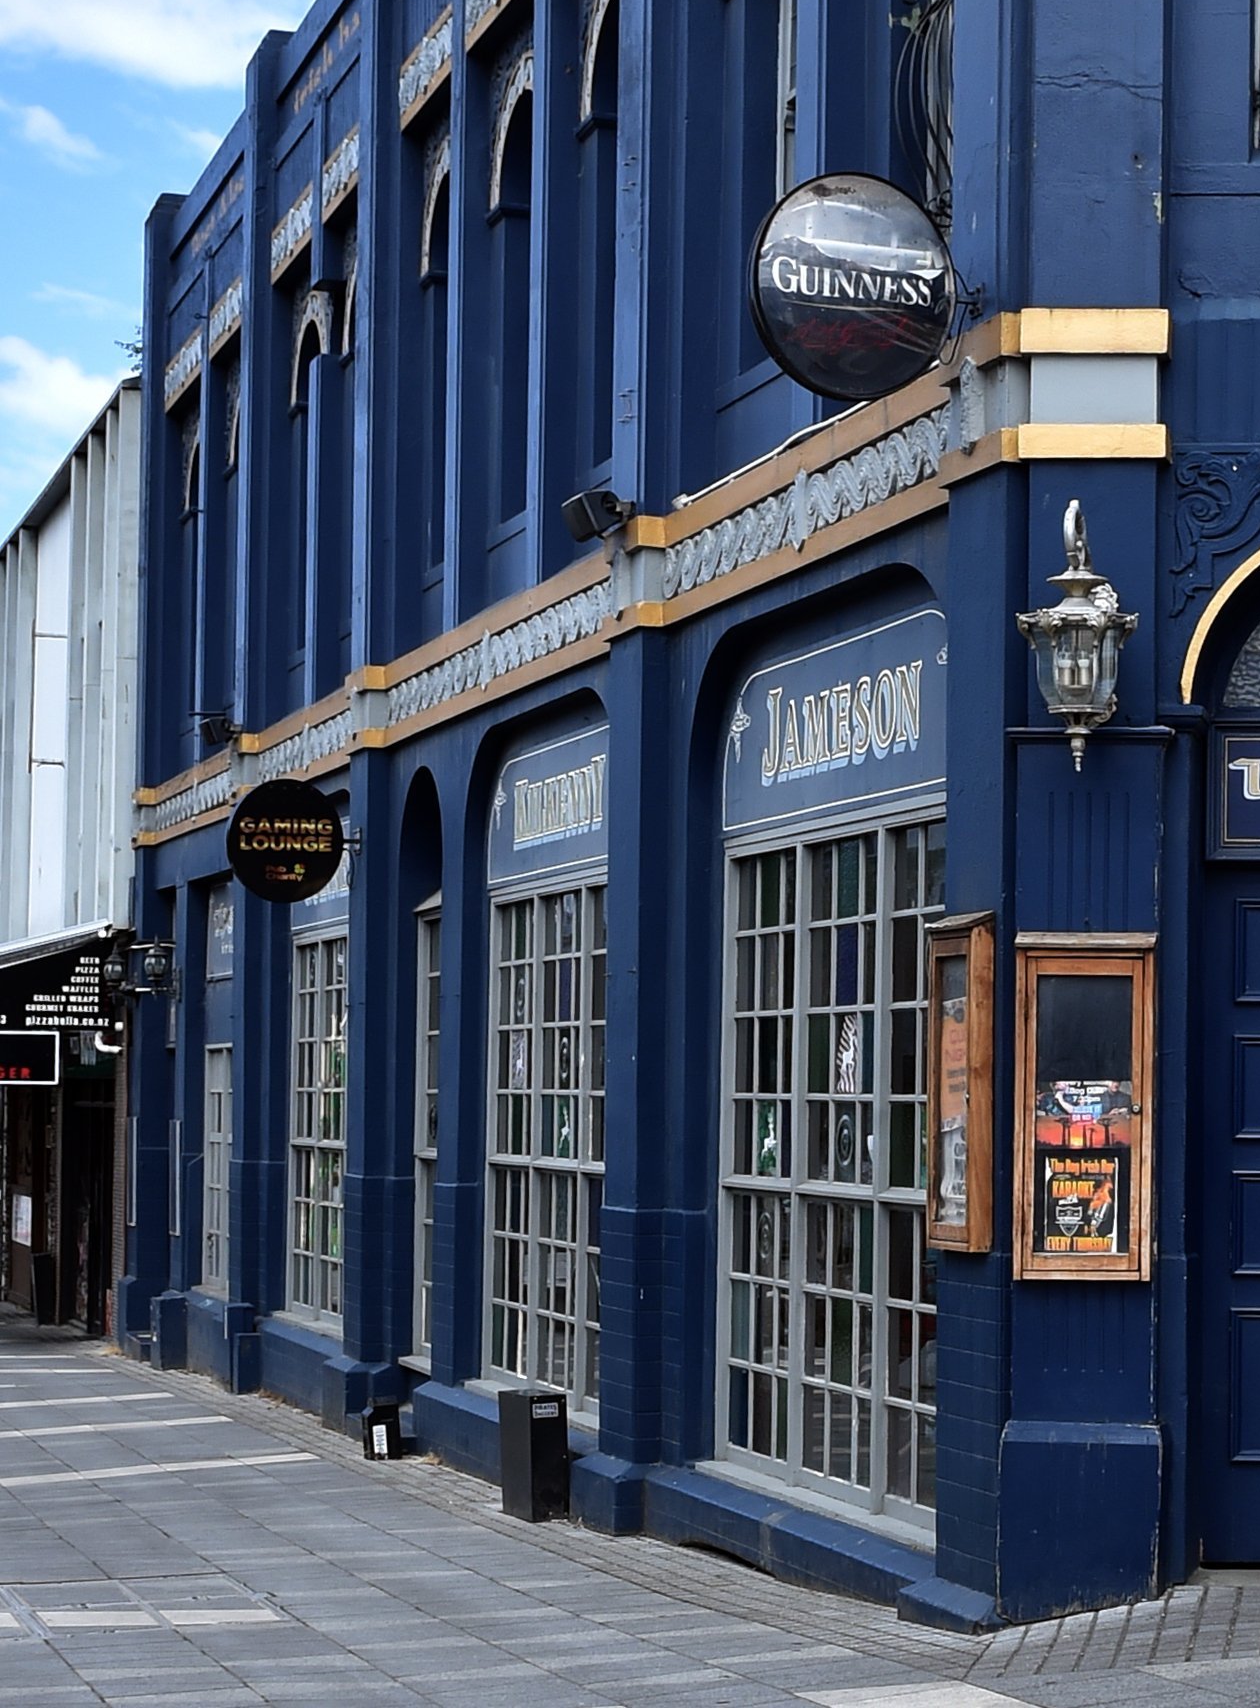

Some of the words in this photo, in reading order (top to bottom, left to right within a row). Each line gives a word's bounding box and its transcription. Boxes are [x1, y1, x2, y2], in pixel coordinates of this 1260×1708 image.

[771, 255, 934, 307] GUINNESS
[761, 659, 923, 787] JAMESON
[238, 817, 334, 835] GAMING
[239, 835, 333, 853] LOUNGE
[75, 966, 101, 974] PIZZA
[70, 975, 100, 984] COFFEE
[61, 985, 100, 993] WAFFLES
[69, 995, 99, 1003] WRAPS
[1046, 1236, 1071, 1251] EVERY
